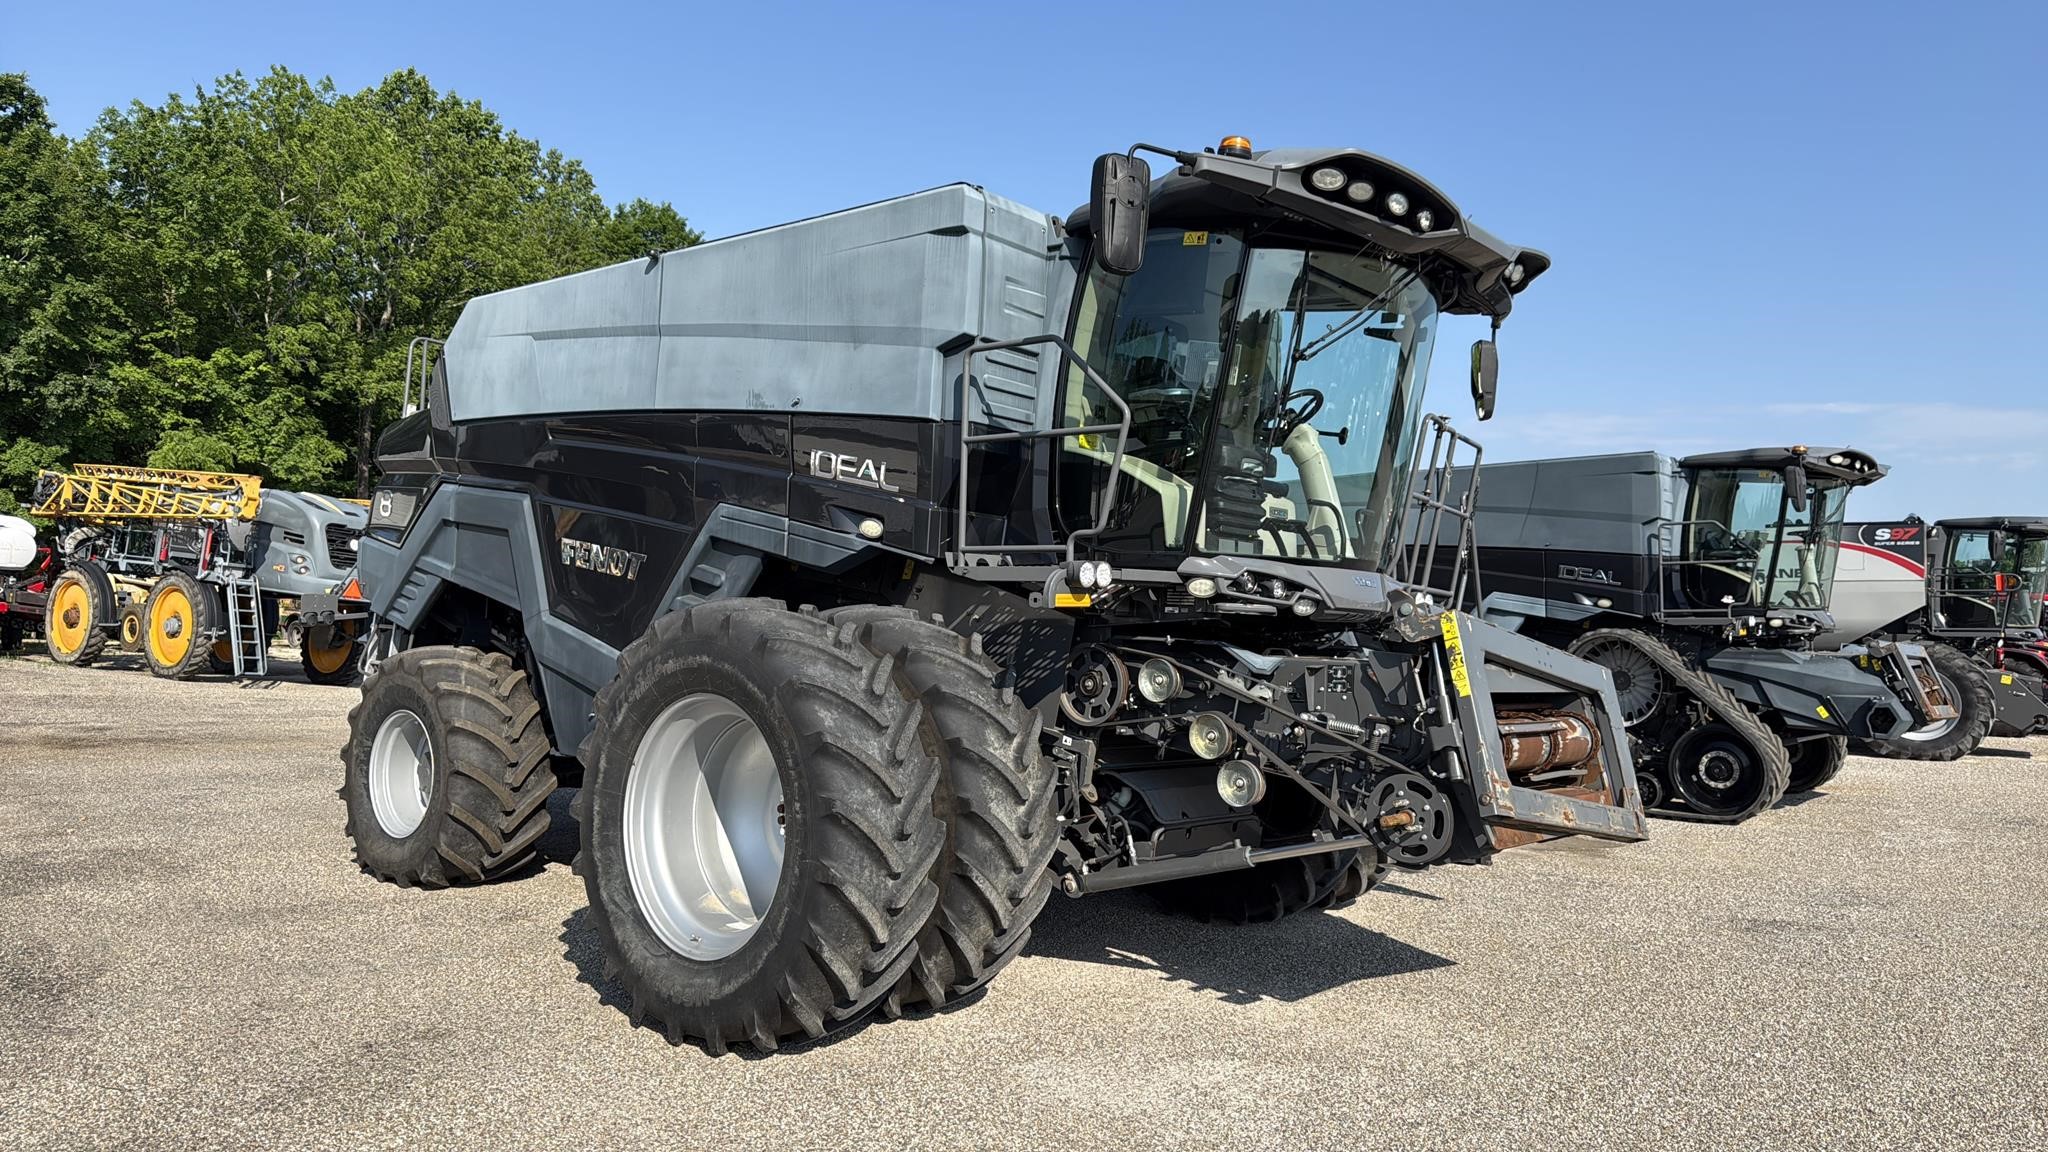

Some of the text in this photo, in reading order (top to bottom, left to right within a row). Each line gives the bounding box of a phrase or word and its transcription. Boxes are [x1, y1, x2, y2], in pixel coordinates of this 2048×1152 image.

[810, 448, 899, 492] IDEAL
[380, 489, 393, 517] 8
[1874, 527, 1921, 541] S97
[561, 537, 648, 581] FENDT
[1558, 564, 1622, 586] IDEAL
